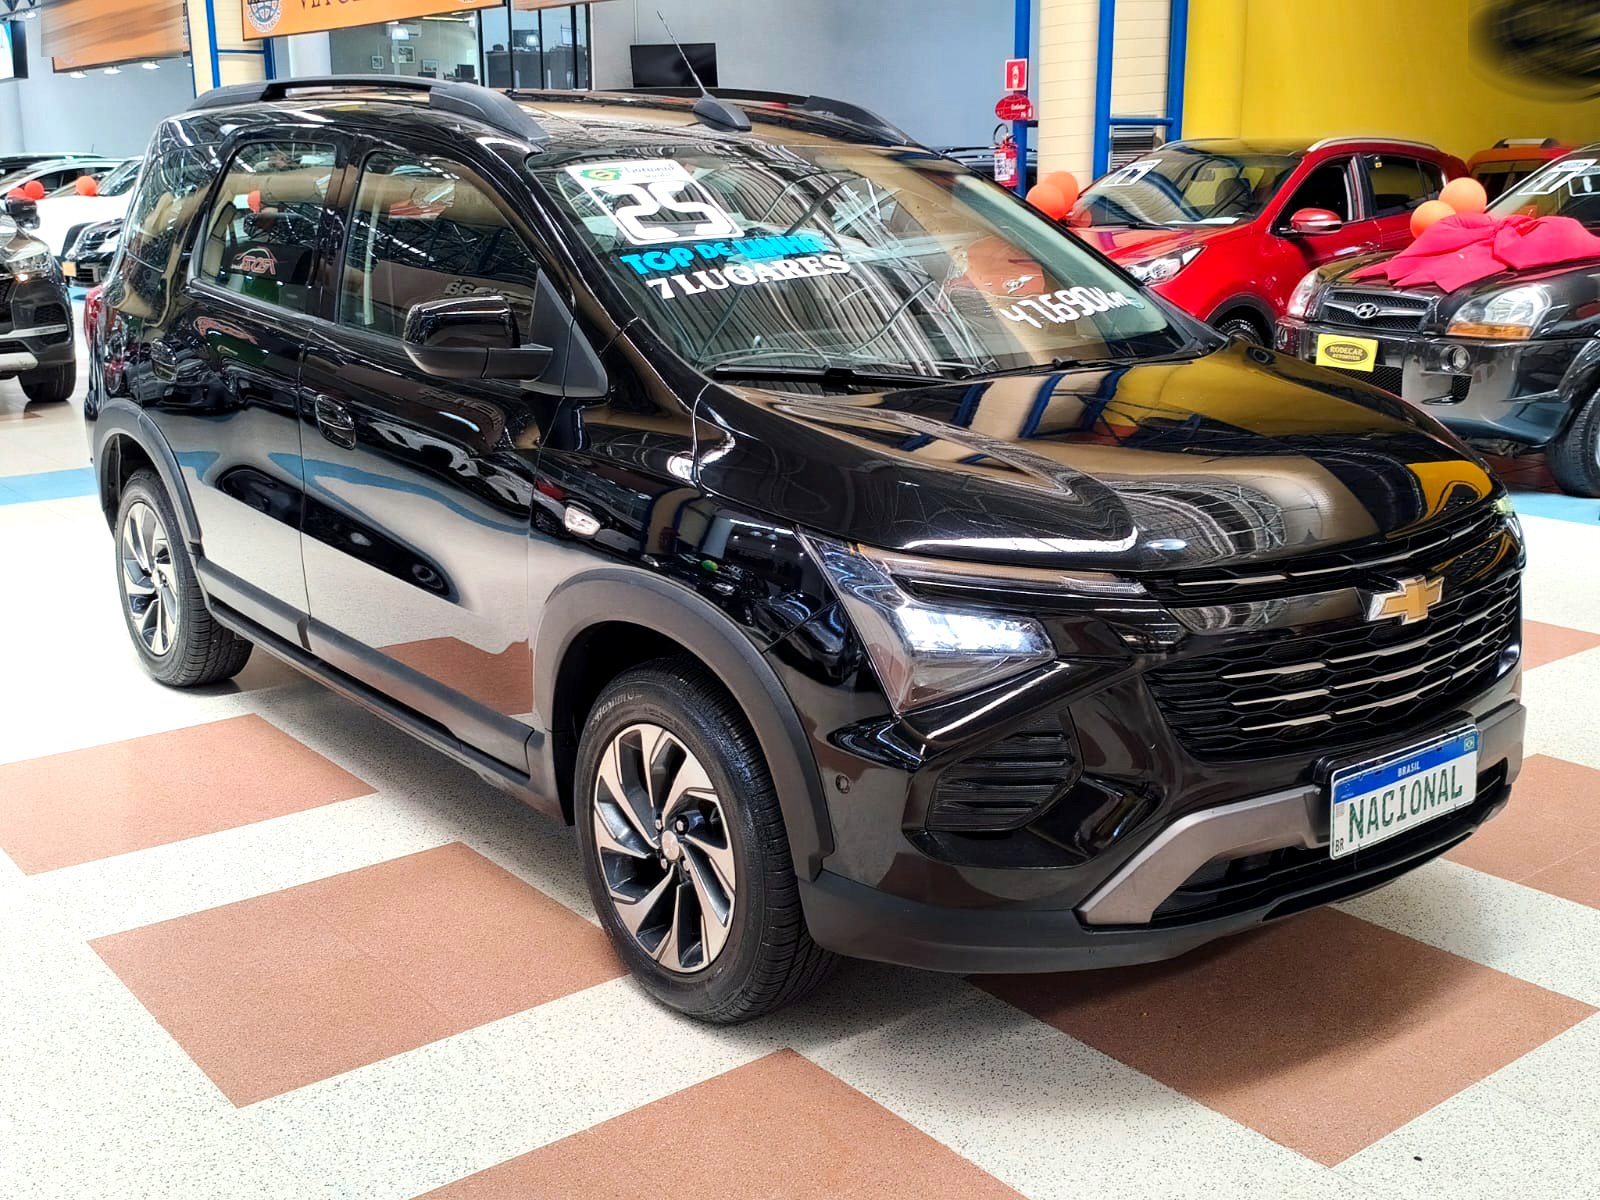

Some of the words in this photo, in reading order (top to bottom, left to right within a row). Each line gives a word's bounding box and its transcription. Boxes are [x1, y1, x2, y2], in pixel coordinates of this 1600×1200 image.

[594, 180, 734, 240] 25
[619, 247, 695, 275] TOP
[695, 241, 735, 260] DE
[733, 233, 831, 260] LINHA
[1397, 763, 1421, 778] BRASIL
[1349, 765, 1463, 843] NACIONAL
[1335, 838, 1344, 852] BR
